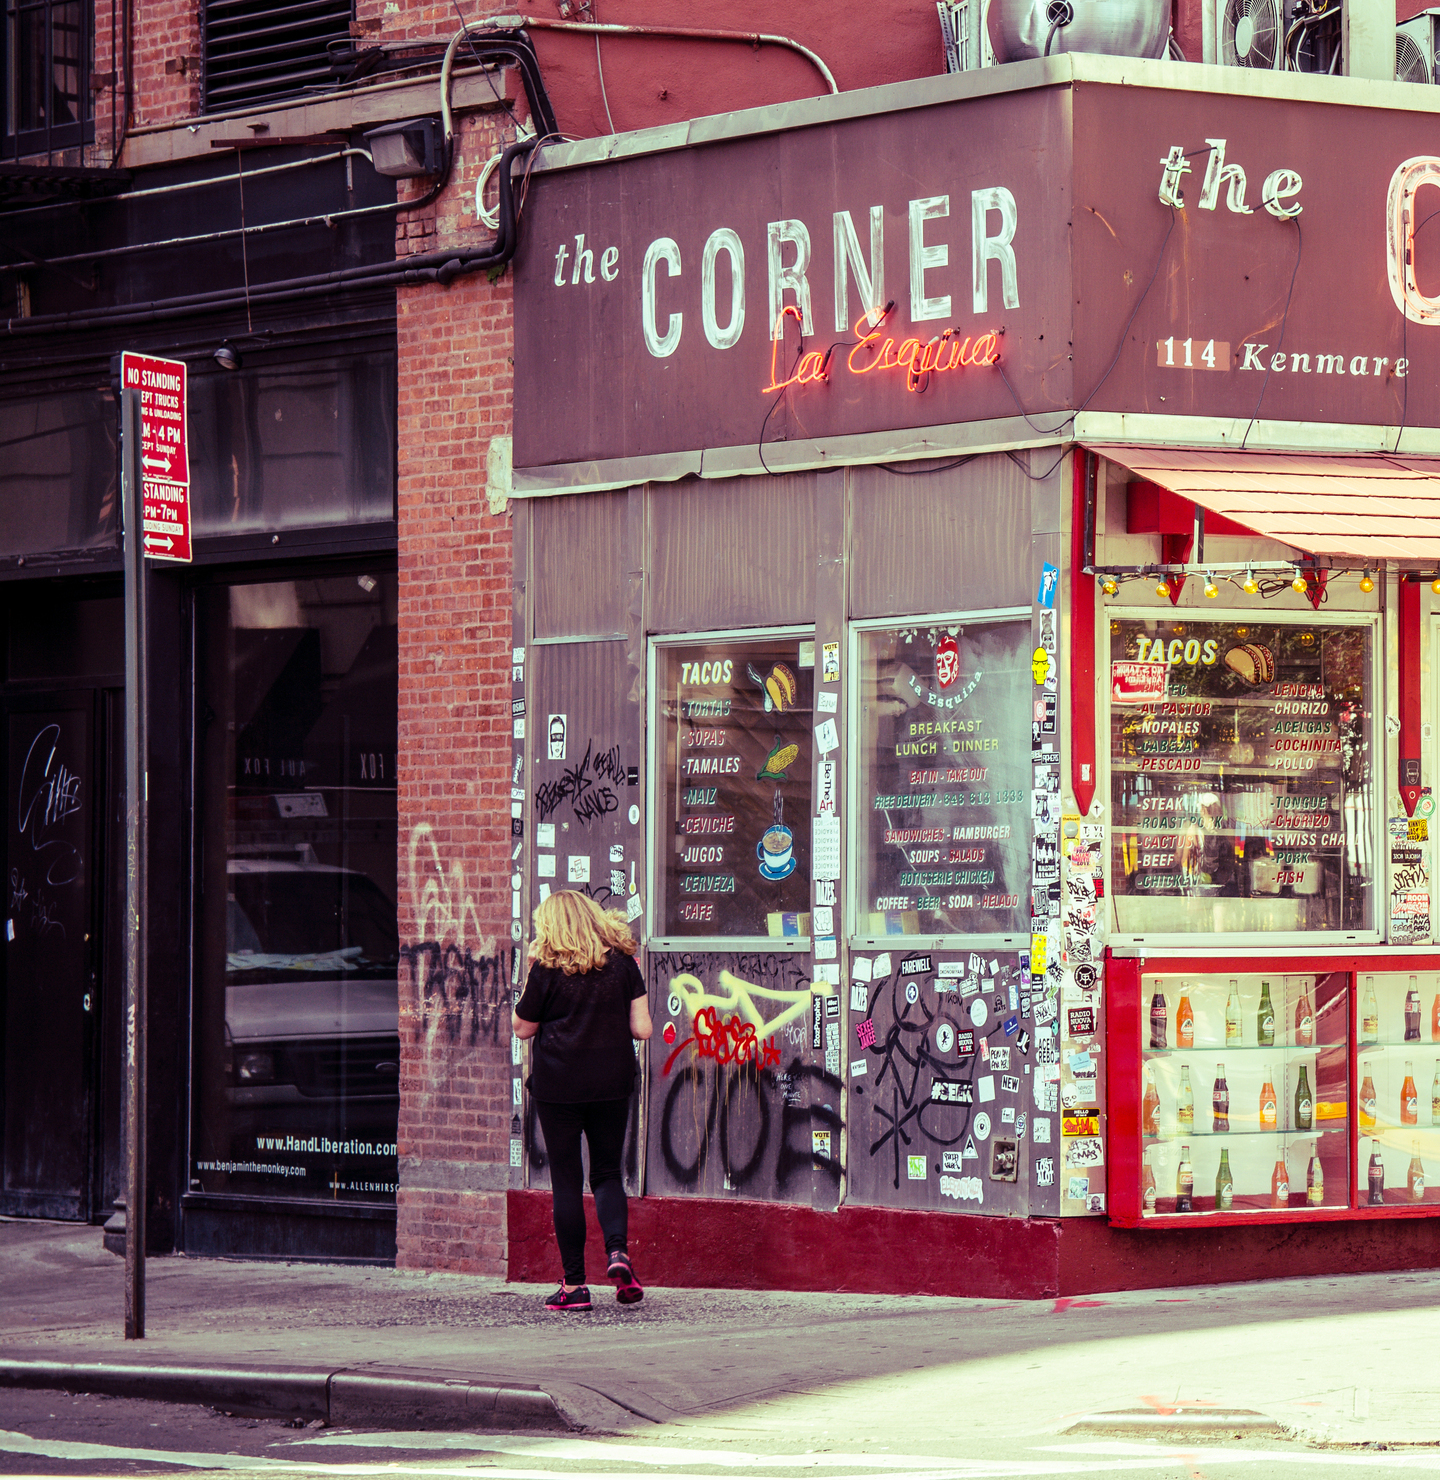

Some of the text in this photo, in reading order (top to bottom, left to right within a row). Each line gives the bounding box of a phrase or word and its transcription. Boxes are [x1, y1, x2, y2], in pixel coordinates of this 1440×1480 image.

[1158, 138, 1303, 217] the
[555, 187, 1020, 358] the CORNER
[762, 304, 998, 393] La Esquina
[1164, 335, 1410, 378] 114 Kenmare
[128, 367, 181, 391] NO STANDING
[155, 393, 179, 408] TRUCKS
[154, 409, 182, 421] UNLOADING
[158, 426, 181, 443] 4 PM
[156, 443, 176, 455] SUNDAY
[144, 484, 184, 503] STANDING
[162, 522, 181, 533] SUNDAY
[1136, 639, 1218, 665] TACOS
[682, 659, 733, 685] TACOS
[928, 671, 982, 709] Esquina
[1275, 684, 1324, 697] LENGUA
[687, 700, 731, 716] TORTAS
[1141, 703, 1211, 716] AL PASTOR
[1275, 702, 1329, 715] CHORIZO
[910, 720, 982, 736] BREAKFAST
[1141, 721, 1200, 734] NOPALES
[1275, 721, 1332, 734] ACELGAS
[688, 729, 726, 746] SOPAS
[896, 739, 999, 757] LUNCH DINNER
[1142, 740, 1193, 753] CABEZA
[1275, 740, 1342, 752] COCHINITA
[687, 757, 740, 774] TAMALES
[1142, 759, 1201, 771] PESCADO
[1275, 757, 1314, 770] POLLO
[910, 768, 988, 784] EAT IN TAKE OUT
[687, 788, 717, 805] MAIZ
[875, 796, 895, 809] FREE
[897, 793, 937, 808] DELIVERY
[1142, 797, 1184, 811] STEAK
[1276, 796, 1327, 810] TONGUE
[686, 816, 734, 833] CEVICHE
[1142, 817, 1187, 829] ROAST
[1276, 815, 1330, 828] CHORIZO
[885, 826, 1011, 844] SANDWICHES HAMBURGER
[1143, 835, 1193, 848] CACTUS
[1276, 833, 1316, 846] SWISS
[684, 847, 723, 863] JUGOS
[910, 849, 985, 864] SOUPS SALADS
[1142, 854, 1174, 867] BEEF
[1276, 853, 1310, 864] PORK
[685, 875, 735, 892] CERVEZA
[900, 871, 994, 886] ROTISSERIE CHICKEN
[1143, 875, 1200, 888] CHICKEN
[1277, 871, 1305, 884] FISH
[877, 894, 1019, 910] COFFEE BEER SODA HELADO
[685, 904, 713, 920] CAFE
[902, 958, 931, 974] FAREWELL
[1003, 1076, 1018, 1091] NEW
[257, 1135, 397, 1155] www.HandLiberation.com
[197, 1159, 306, 1177] www.benjaminthemonkey.com
